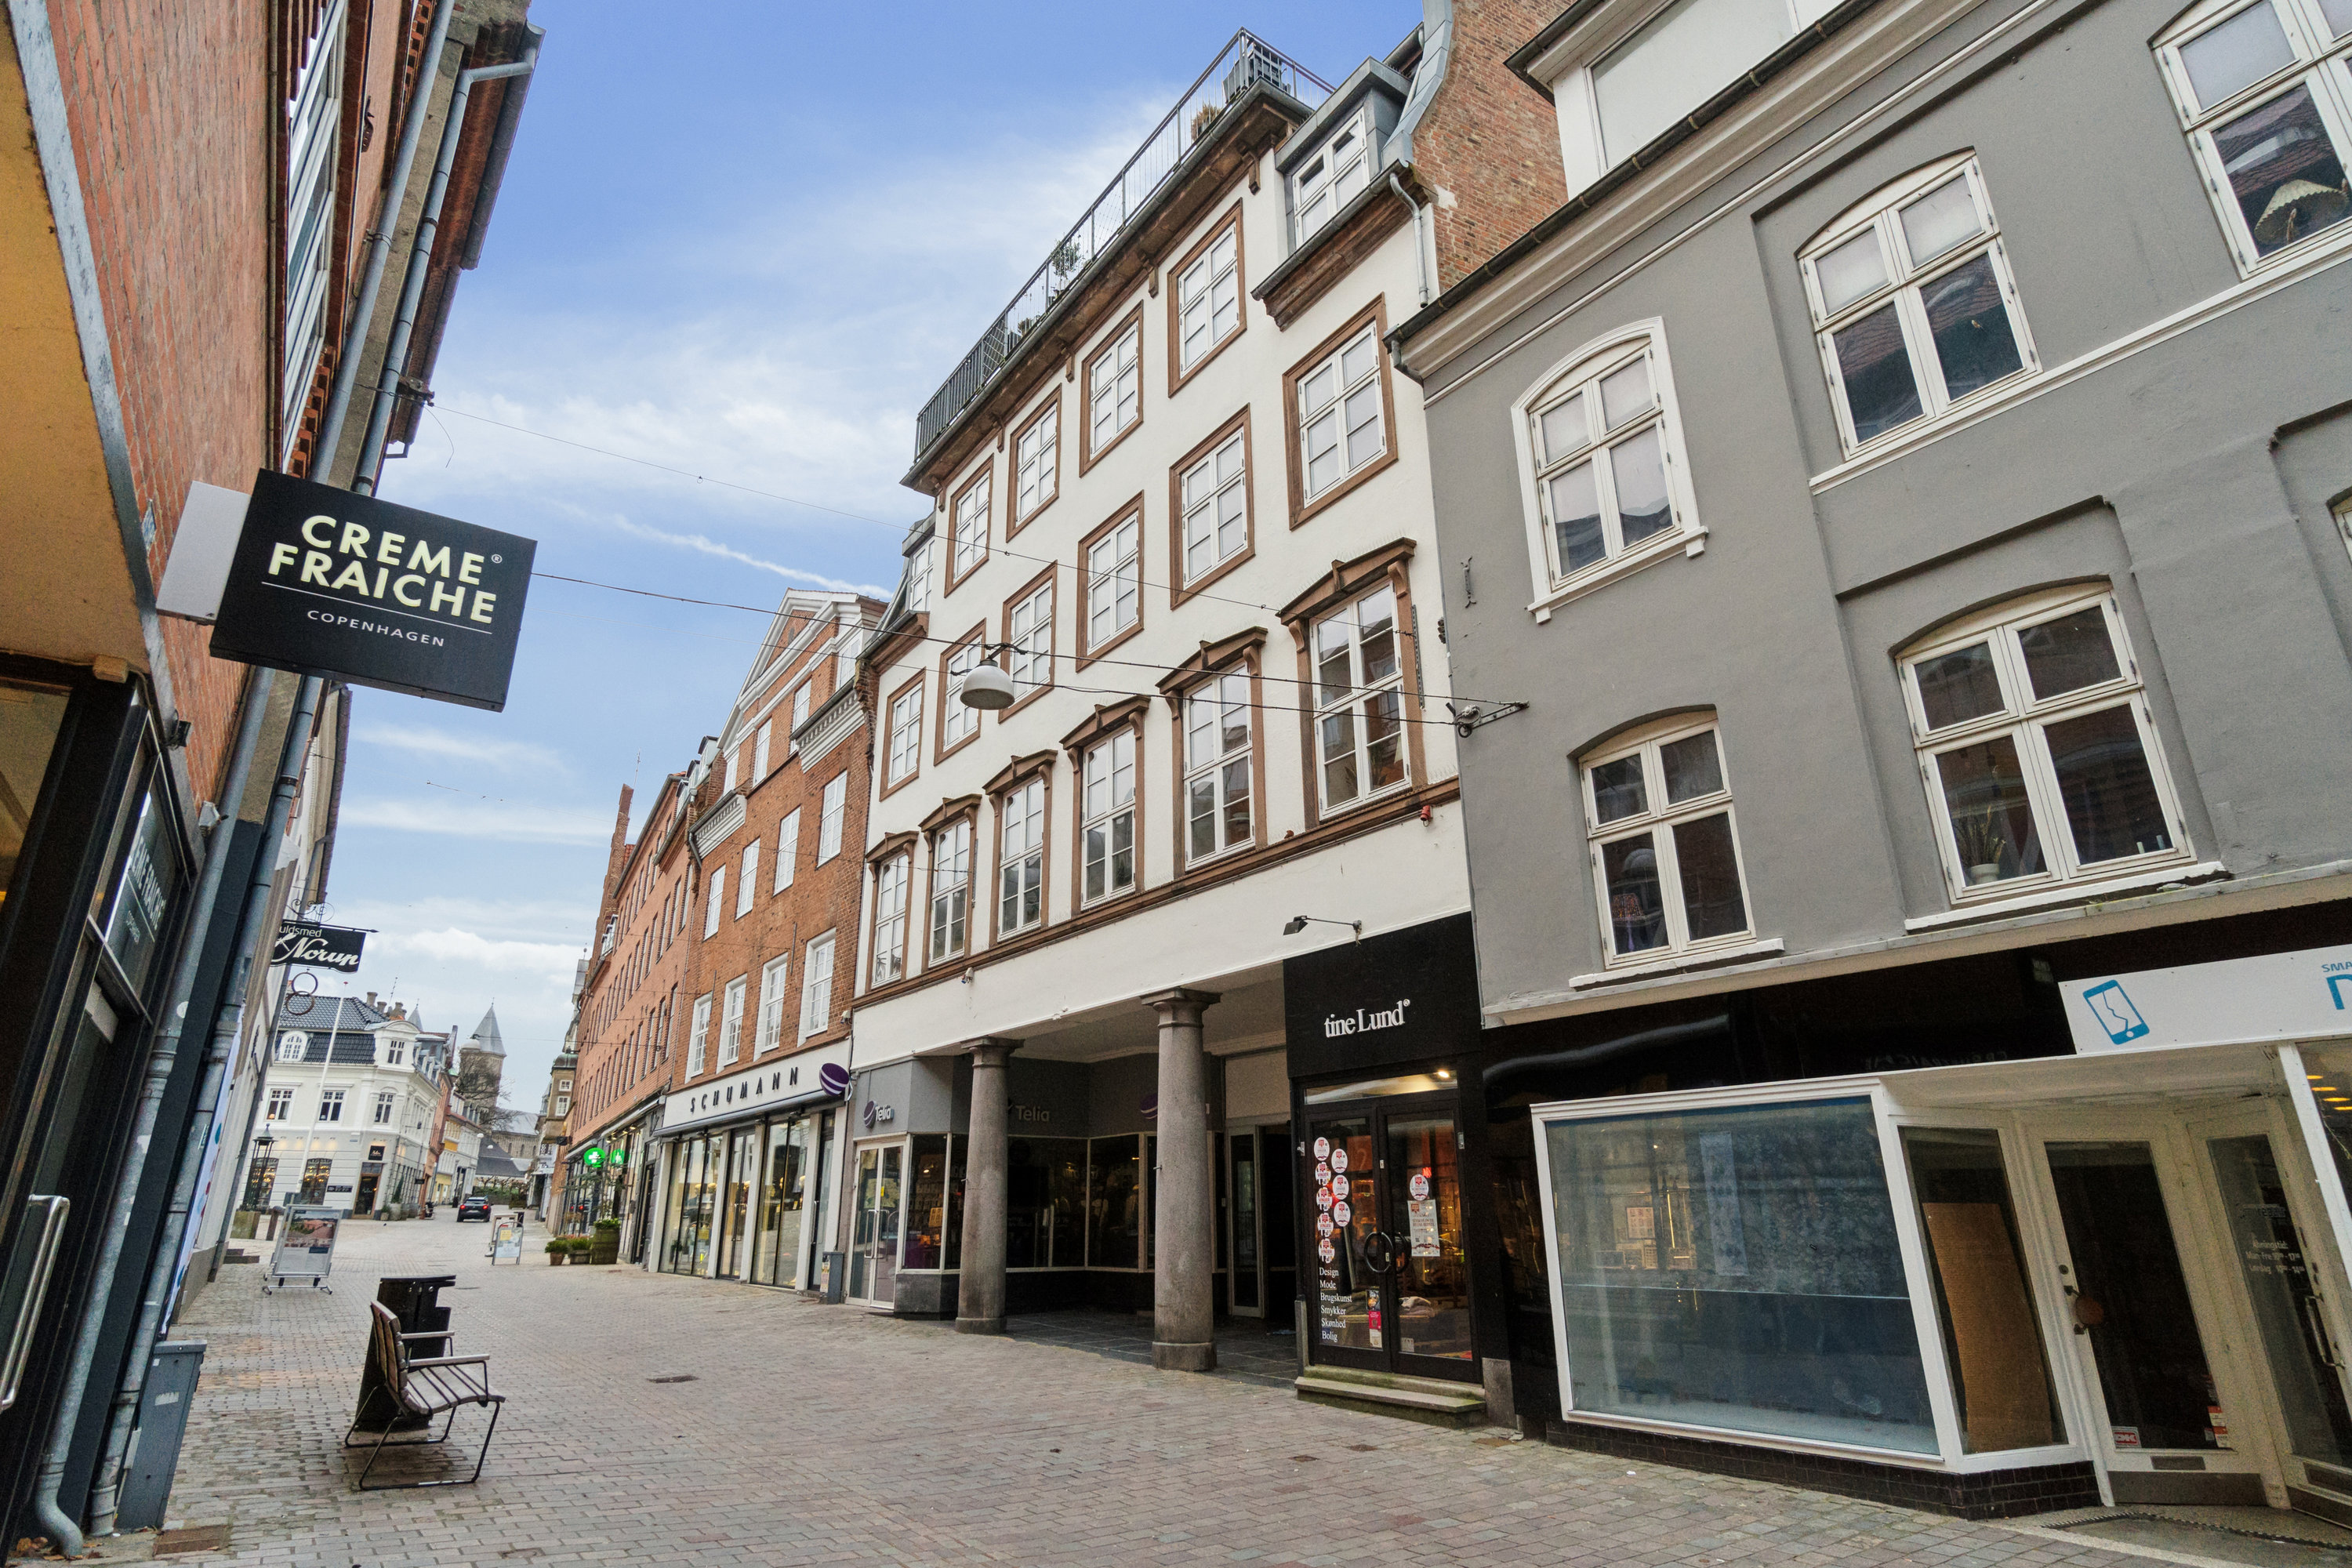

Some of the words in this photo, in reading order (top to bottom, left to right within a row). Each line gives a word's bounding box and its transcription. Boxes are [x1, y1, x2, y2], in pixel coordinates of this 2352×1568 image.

[267, 542, 497, 624] FRAICHE
[307, 609, 445, 648] COPENHAGEN
[1323, 1013, 1356, 1038] tine
[690, 1066, 799, 1113] SCHUMANN
[875, 1104, 892, 1122] Telia
[1015, 1105, 1051, 1122] Telia
[1319, 1267, 1339, 1278] Design
[1319, 1279, 1337, 1289] Mode
[1320, 1292, 1352, 1304] Brugskunst
[1320, 1305, 1346, 1316] Smykker
[1321, 1318, 1346, 1328] Skønhed
[1322, 1330, 1338, 1343] Bolig
